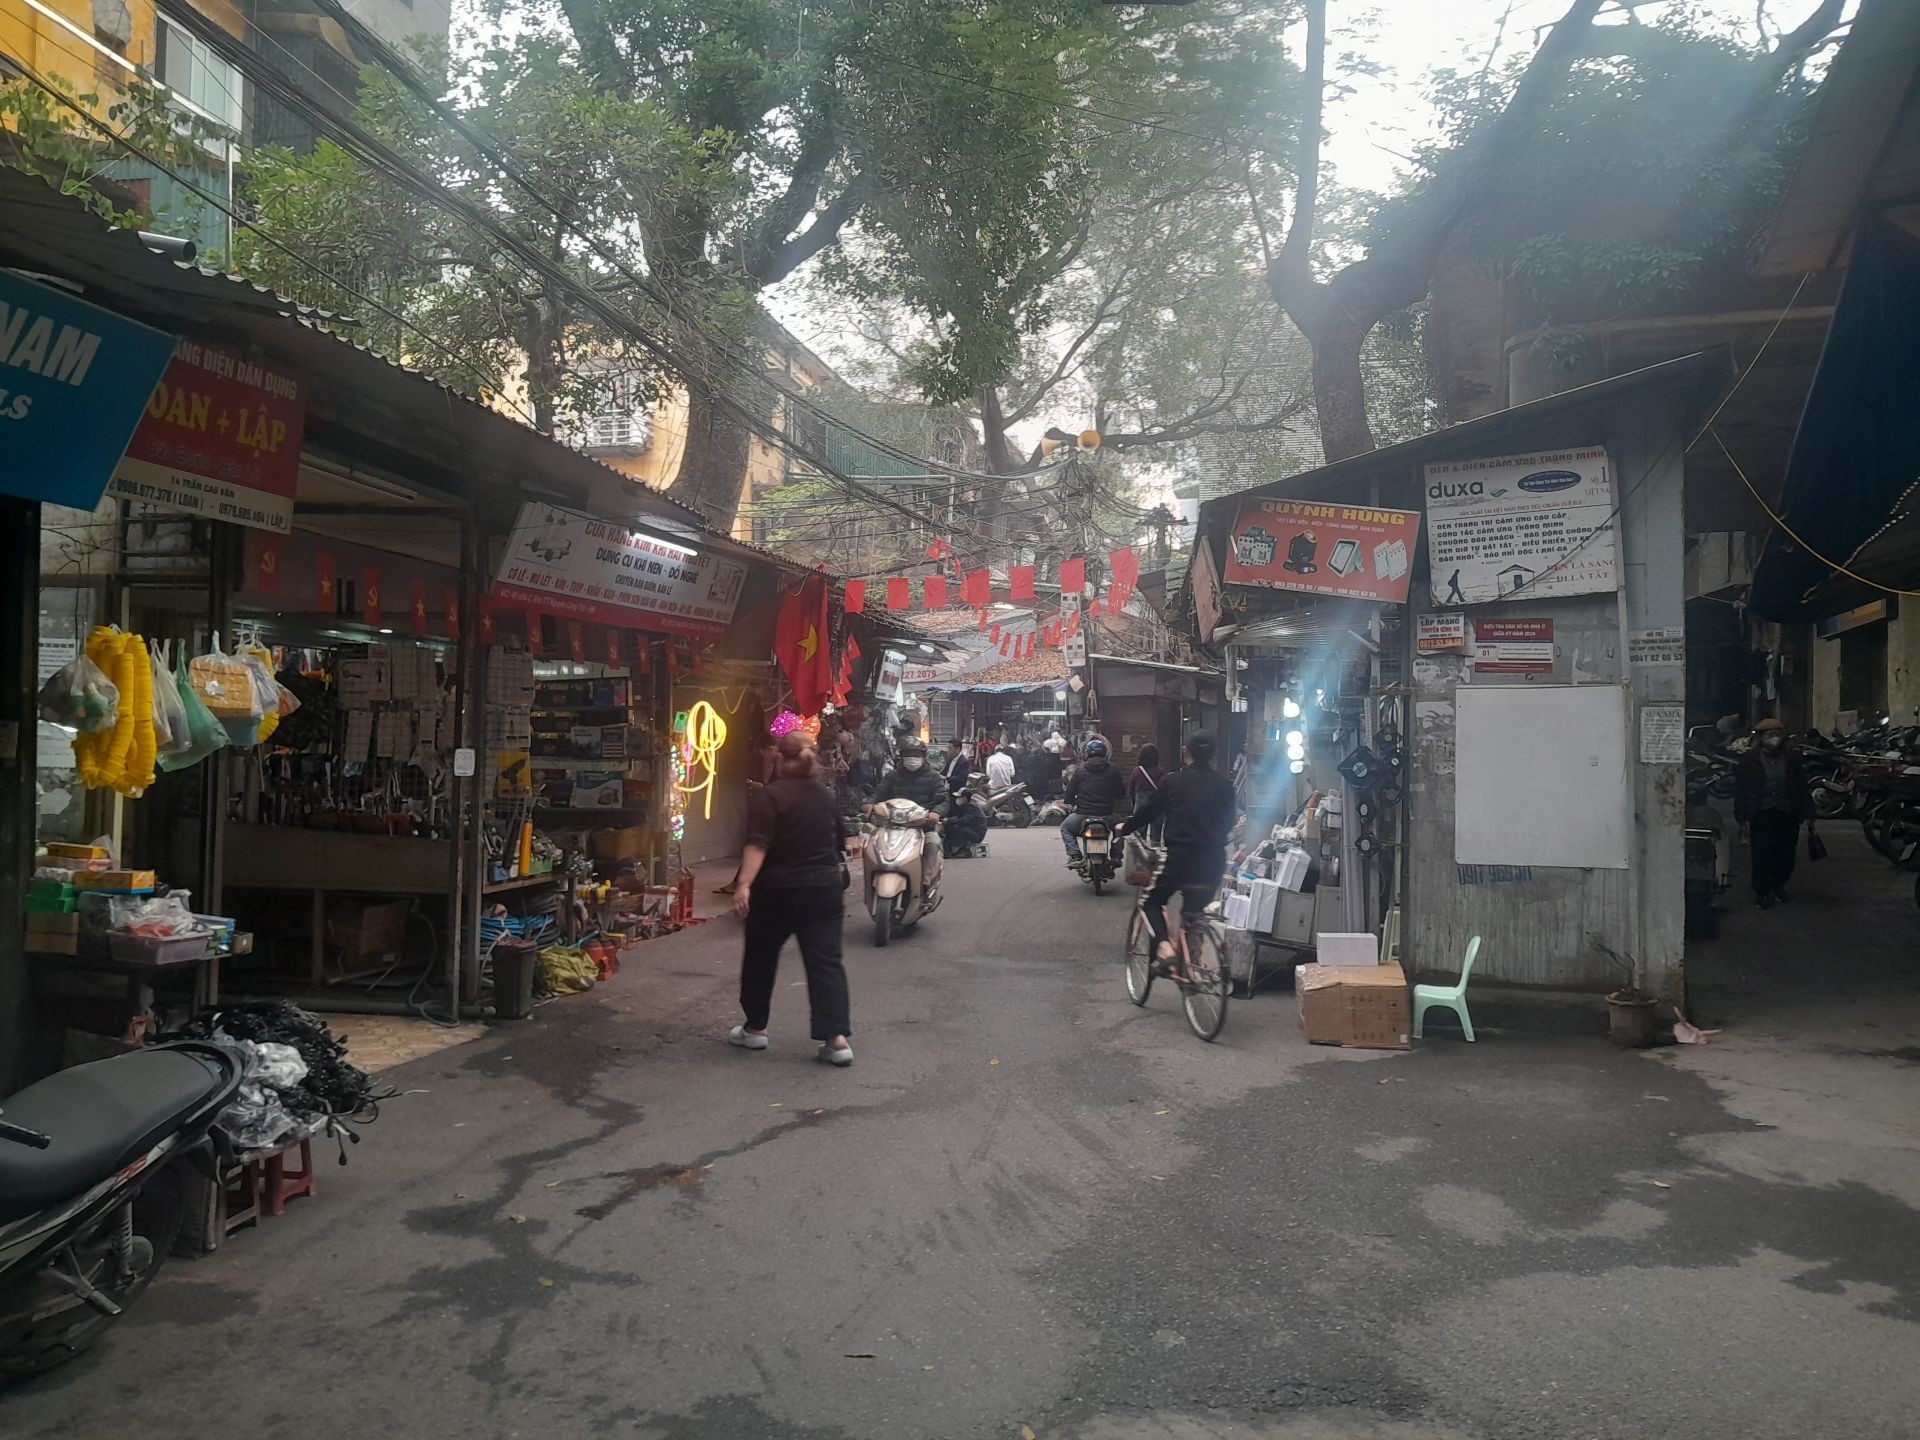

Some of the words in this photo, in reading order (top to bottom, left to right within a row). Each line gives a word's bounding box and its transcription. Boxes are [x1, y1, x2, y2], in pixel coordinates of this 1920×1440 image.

[236, 403, 287, 458] LẬP
[1429, 480, 1484, 499] duxa
[916, 669, 937, 679] 2079
